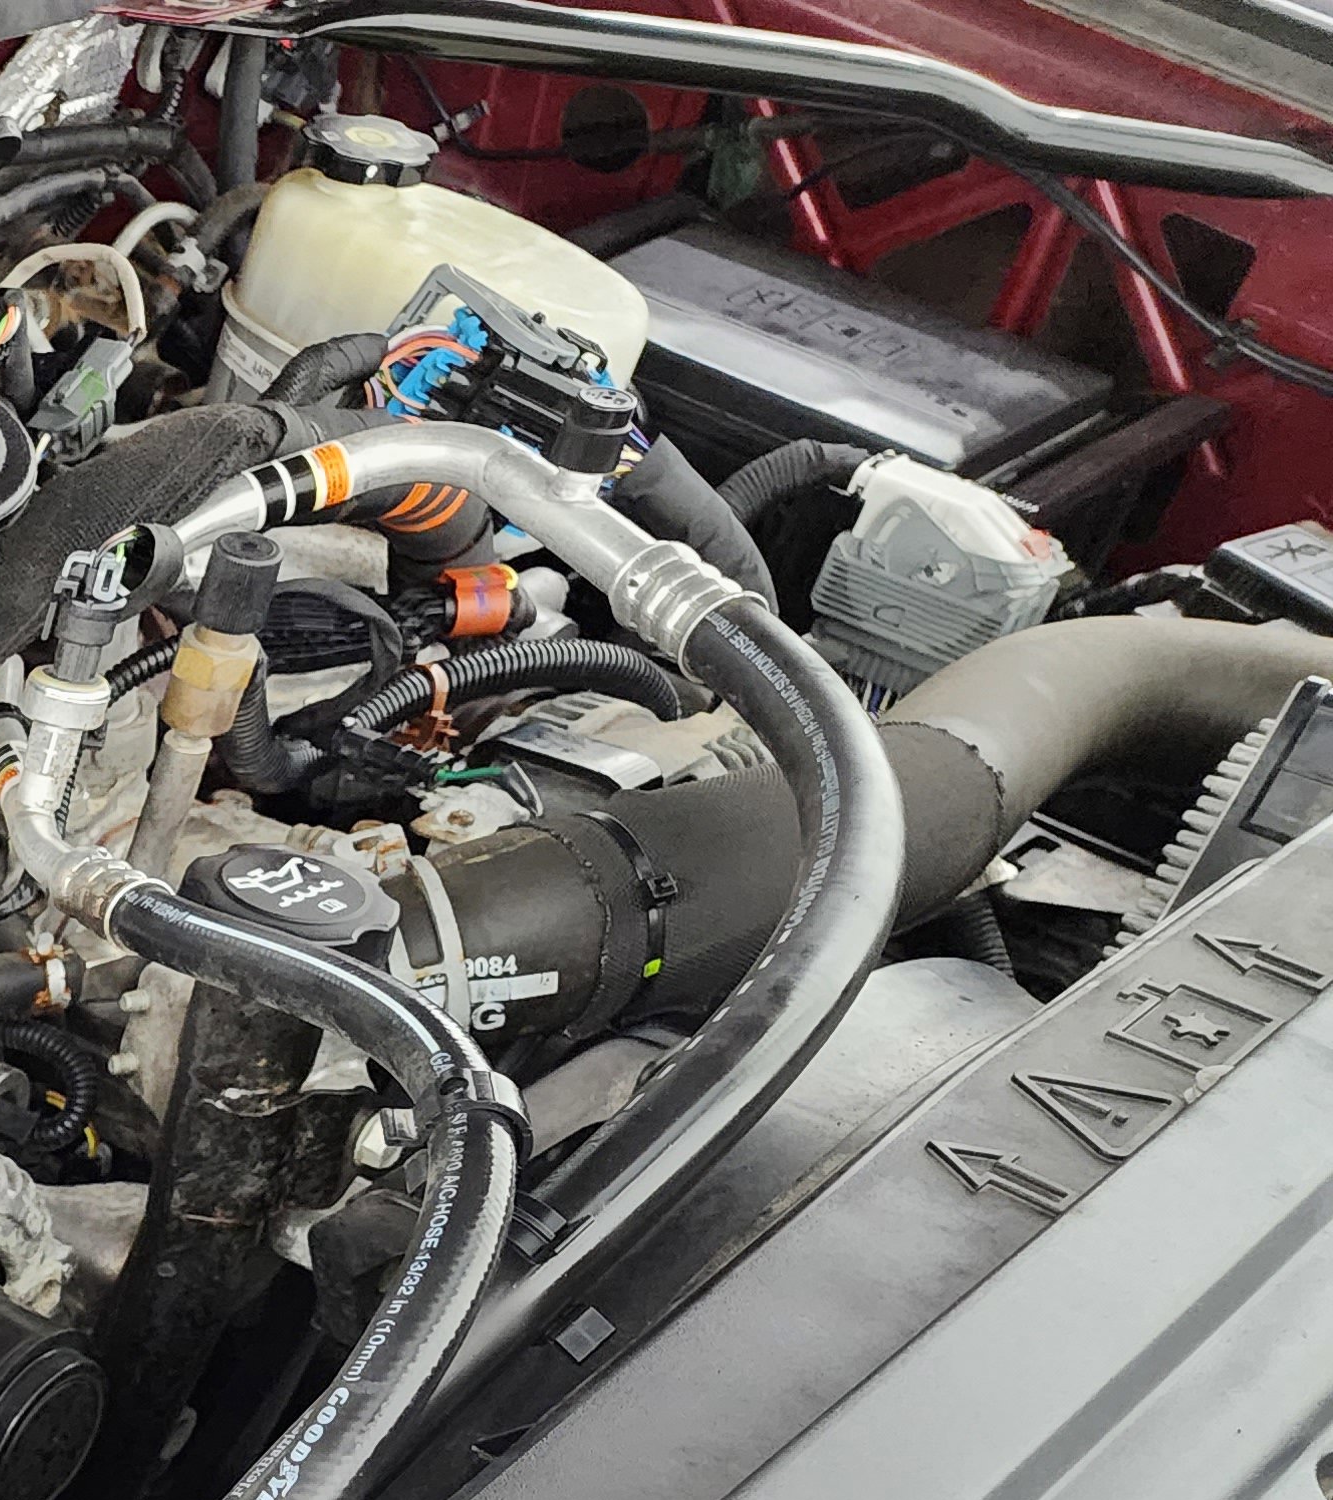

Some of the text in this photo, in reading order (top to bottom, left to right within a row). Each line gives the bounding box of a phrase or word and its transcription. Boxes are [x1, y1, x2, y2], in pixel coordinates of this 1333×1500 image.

[729, 631, 759, 658] HOSE
[753, 653, 789, 689] SUCTION
[470, 1002, 506, 1031] G
[421, 1203, 450, 1247] HOSE
[398, 1251, 429, 1294] 13/32
[344, 1319, 394, 1380] (10mm)
